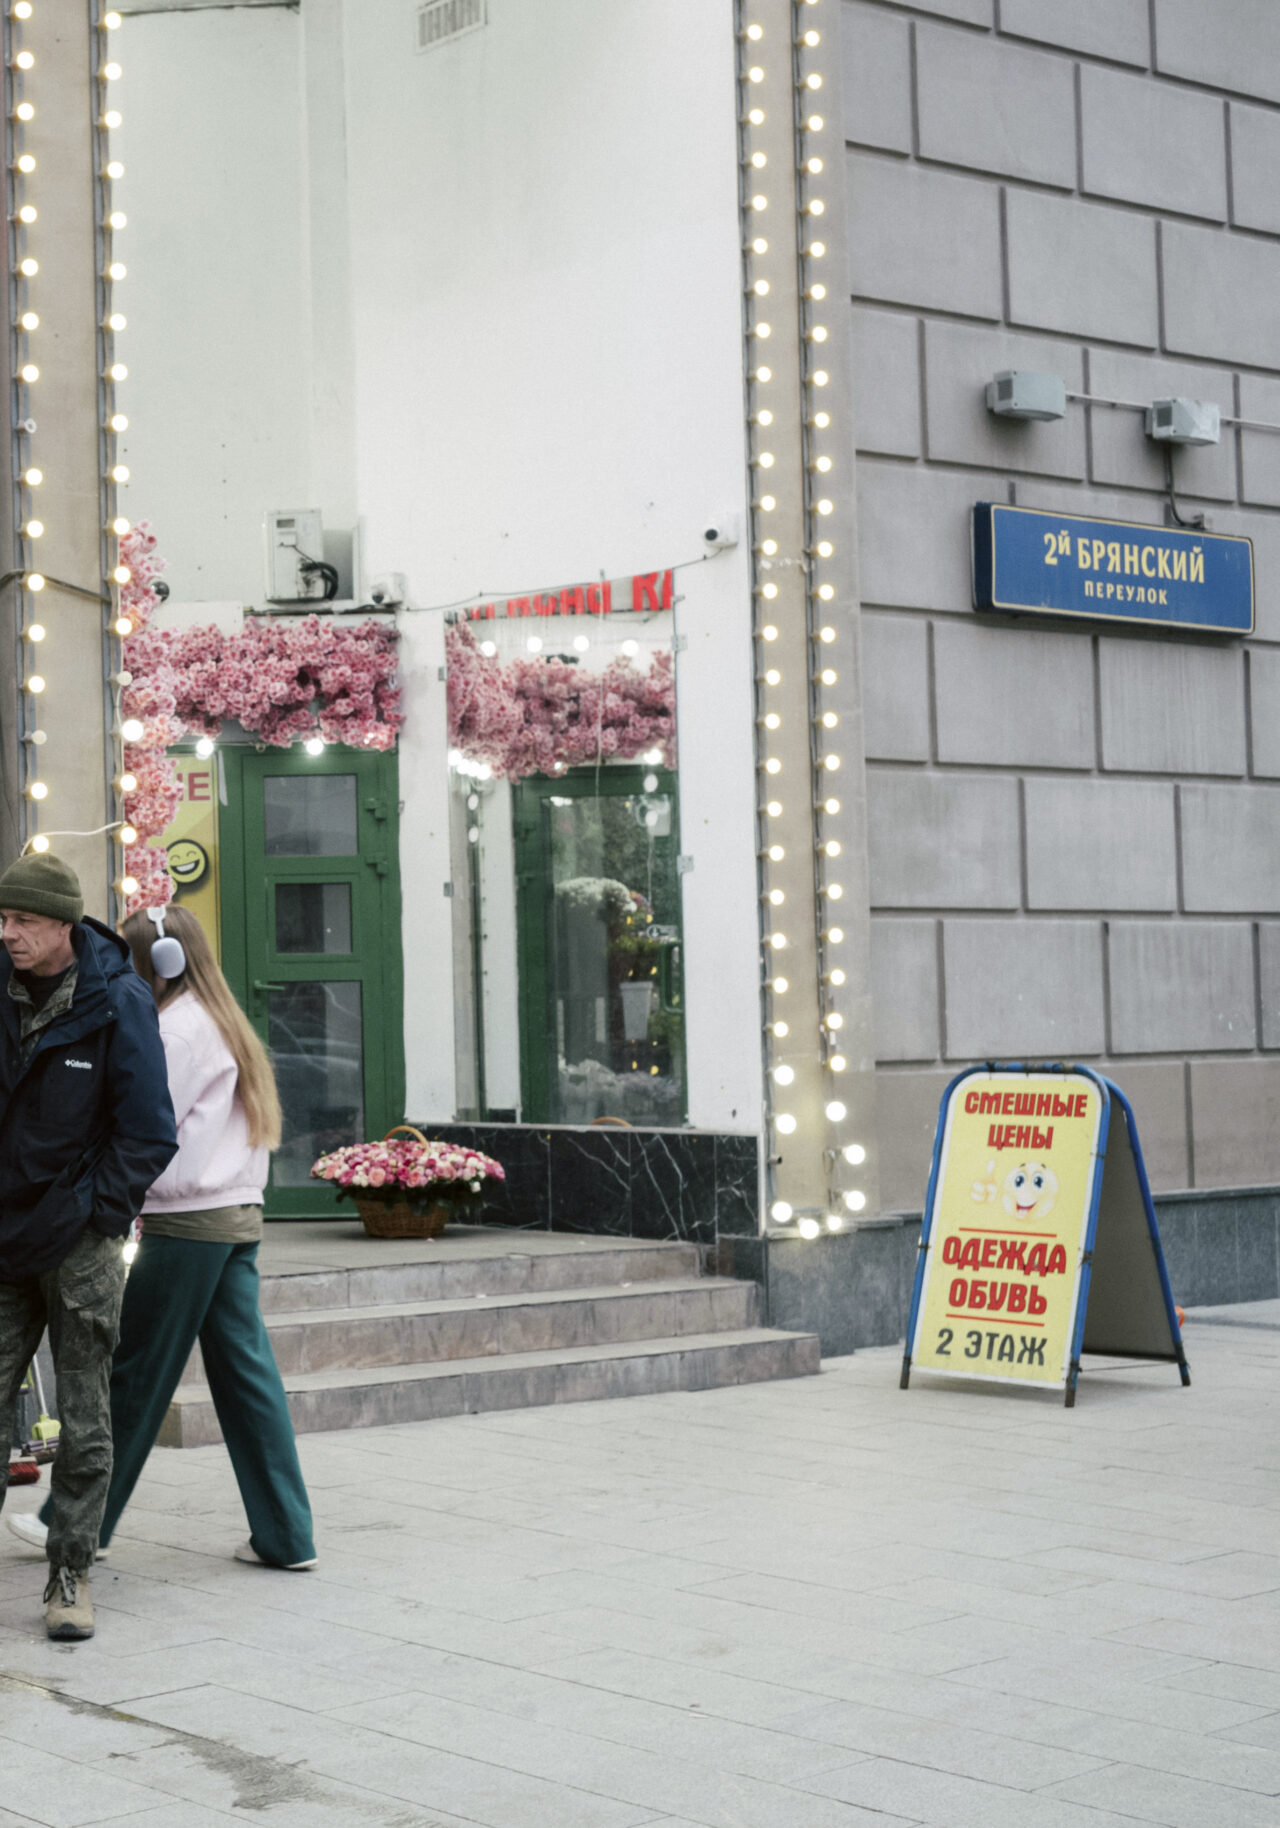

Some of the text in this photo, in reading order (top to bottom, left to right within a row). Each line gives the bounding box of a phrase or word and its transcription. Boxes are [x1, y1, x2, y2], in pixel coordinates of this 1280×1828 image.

[1077, 537, 1205, 583] БРЯНСКИЙ
[1084, 580, 1168, 605] ПЕРЕУЛОК
[965, 1091, 1088, 1118] СМЕШНЫЕ
[987, 1124, 1054, 1151] ЦЕНЫ
[942, 1236, 1066, 1277] ОДЕЖДА
[948, 1278, 1048, 1315] ОБУВЬ
[936, 1328, 1048, 1366] 2 ЭТАЖ
